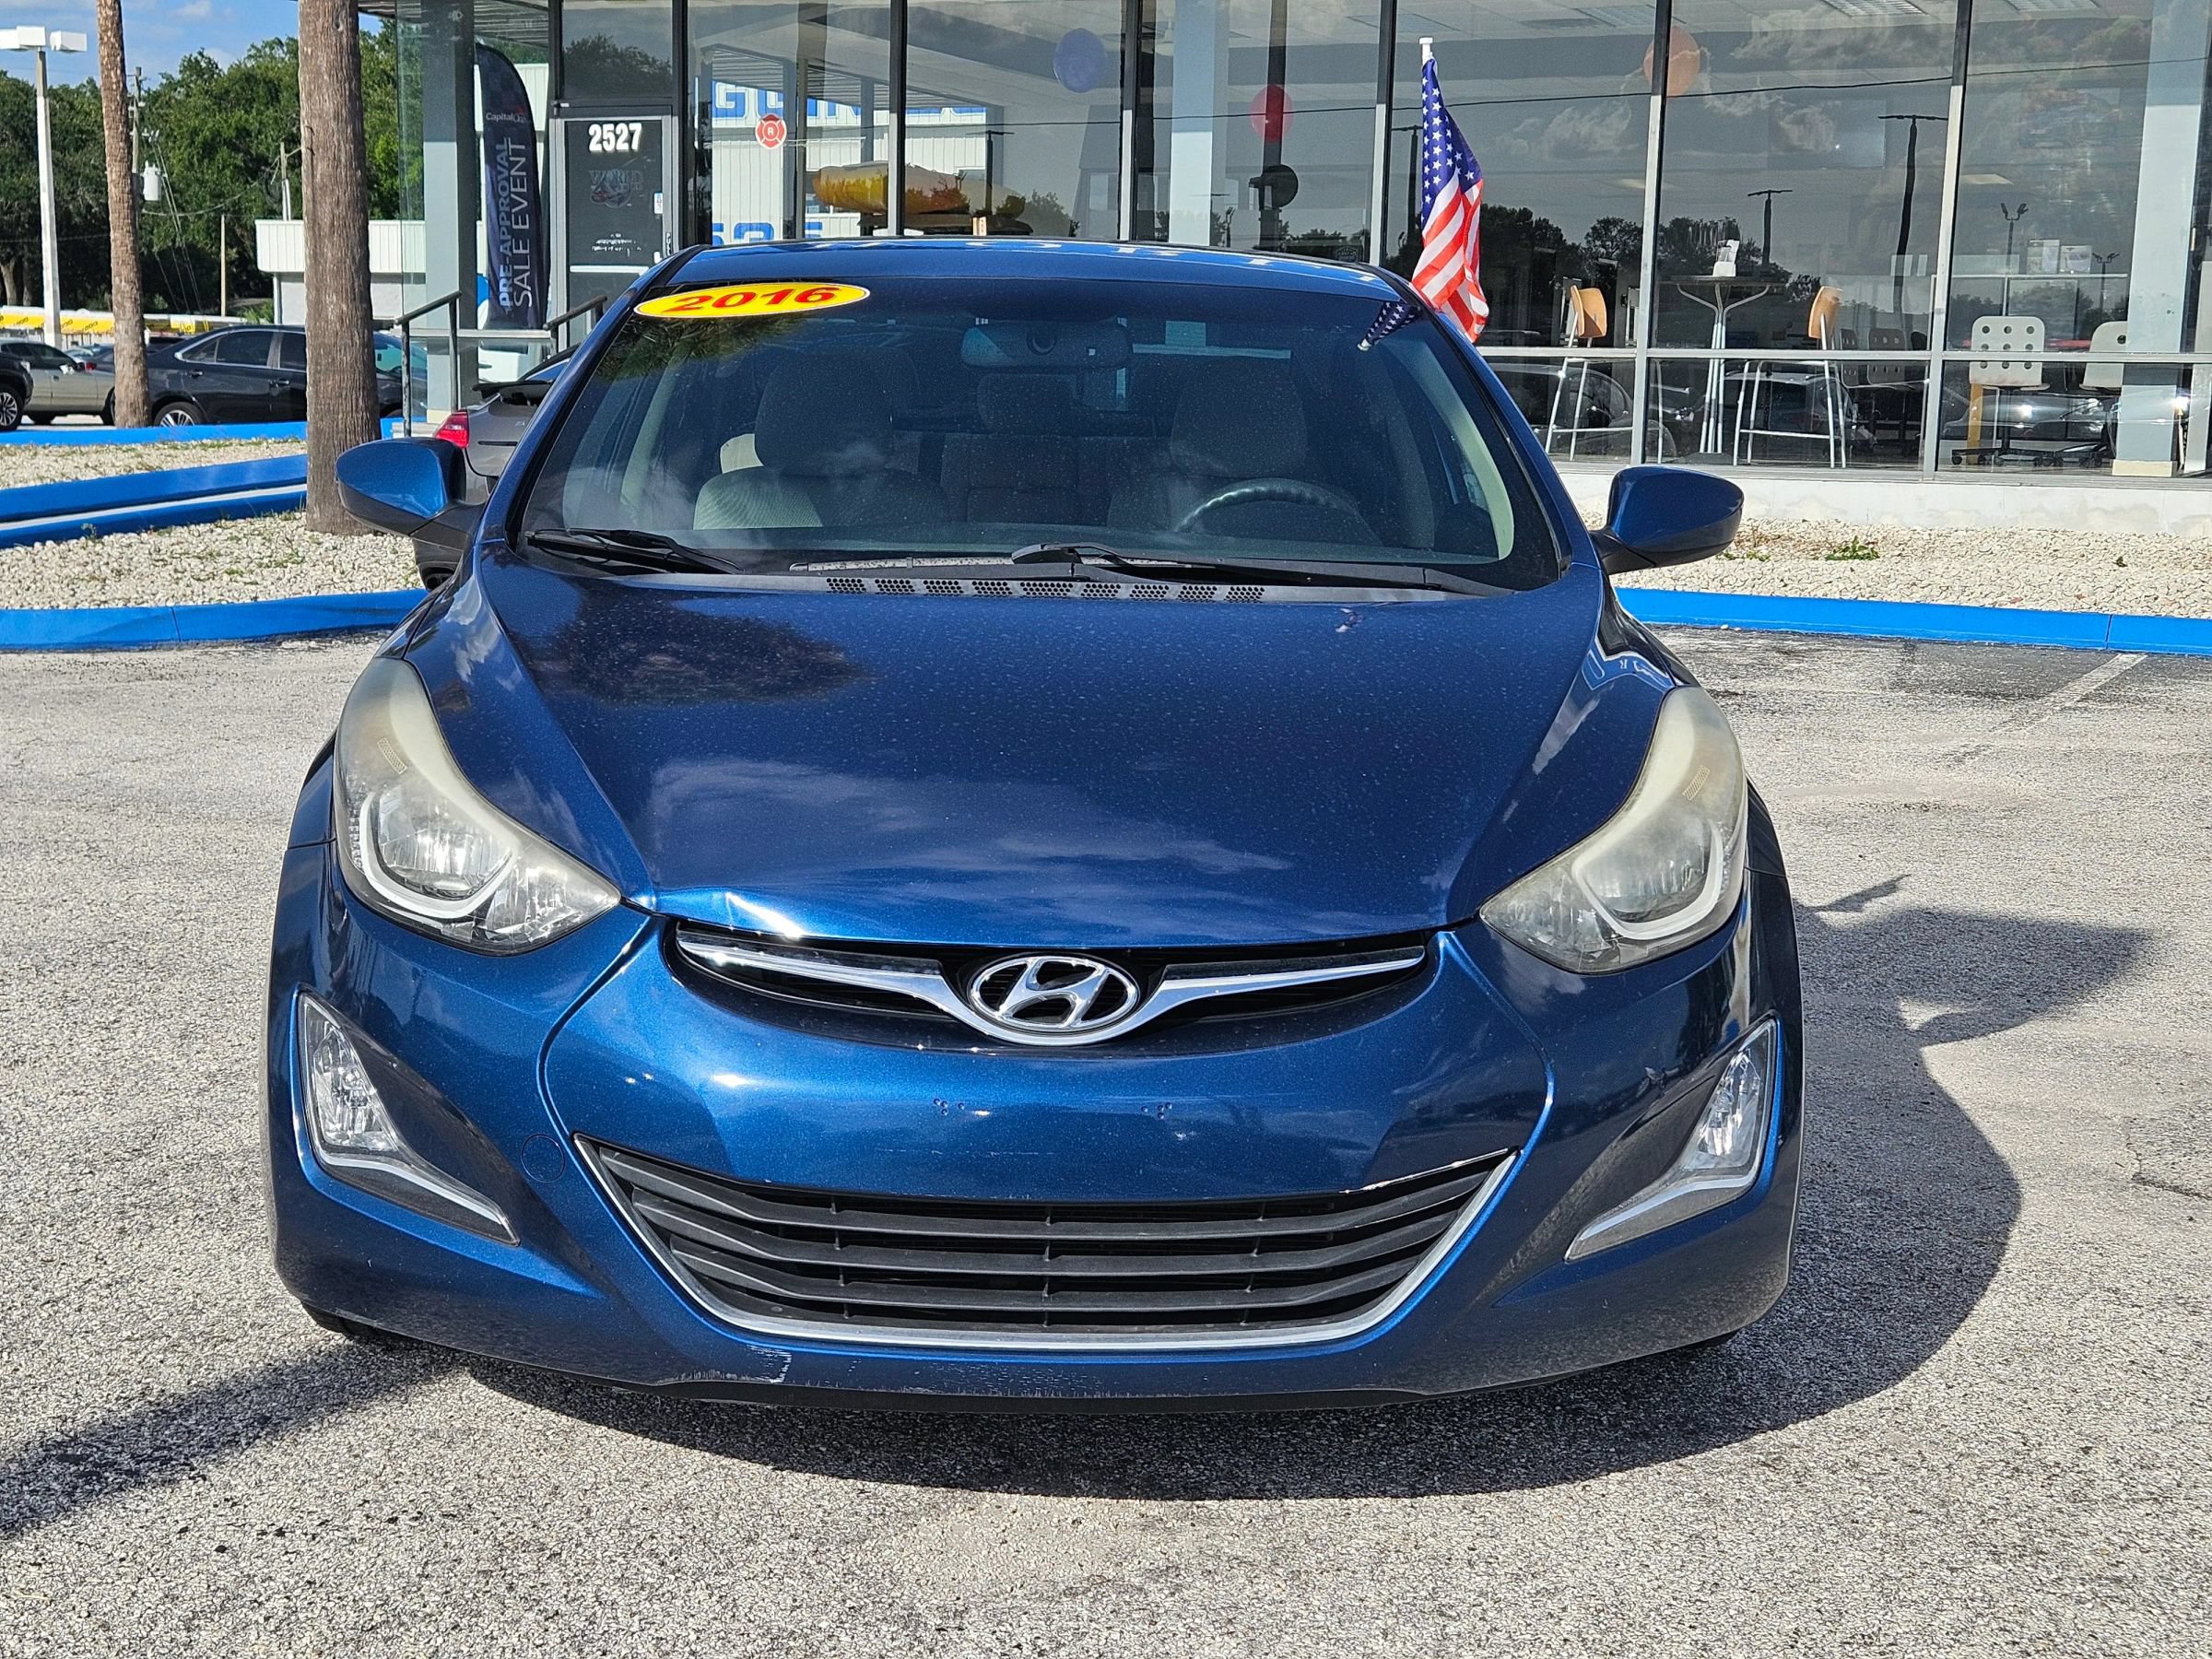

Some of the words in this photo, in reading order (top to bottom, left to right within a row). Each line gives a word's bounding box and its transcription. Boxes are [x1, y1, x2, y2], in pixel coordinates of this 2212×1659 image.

[588, 123, 642, 152] 2527
[509, 137, 529, 230] EVENT
[496, 137, 512, 308] PRE-APPROVAL
[512, 238, 533, 308] SALE
[661, 287, 842, 313] 2016
